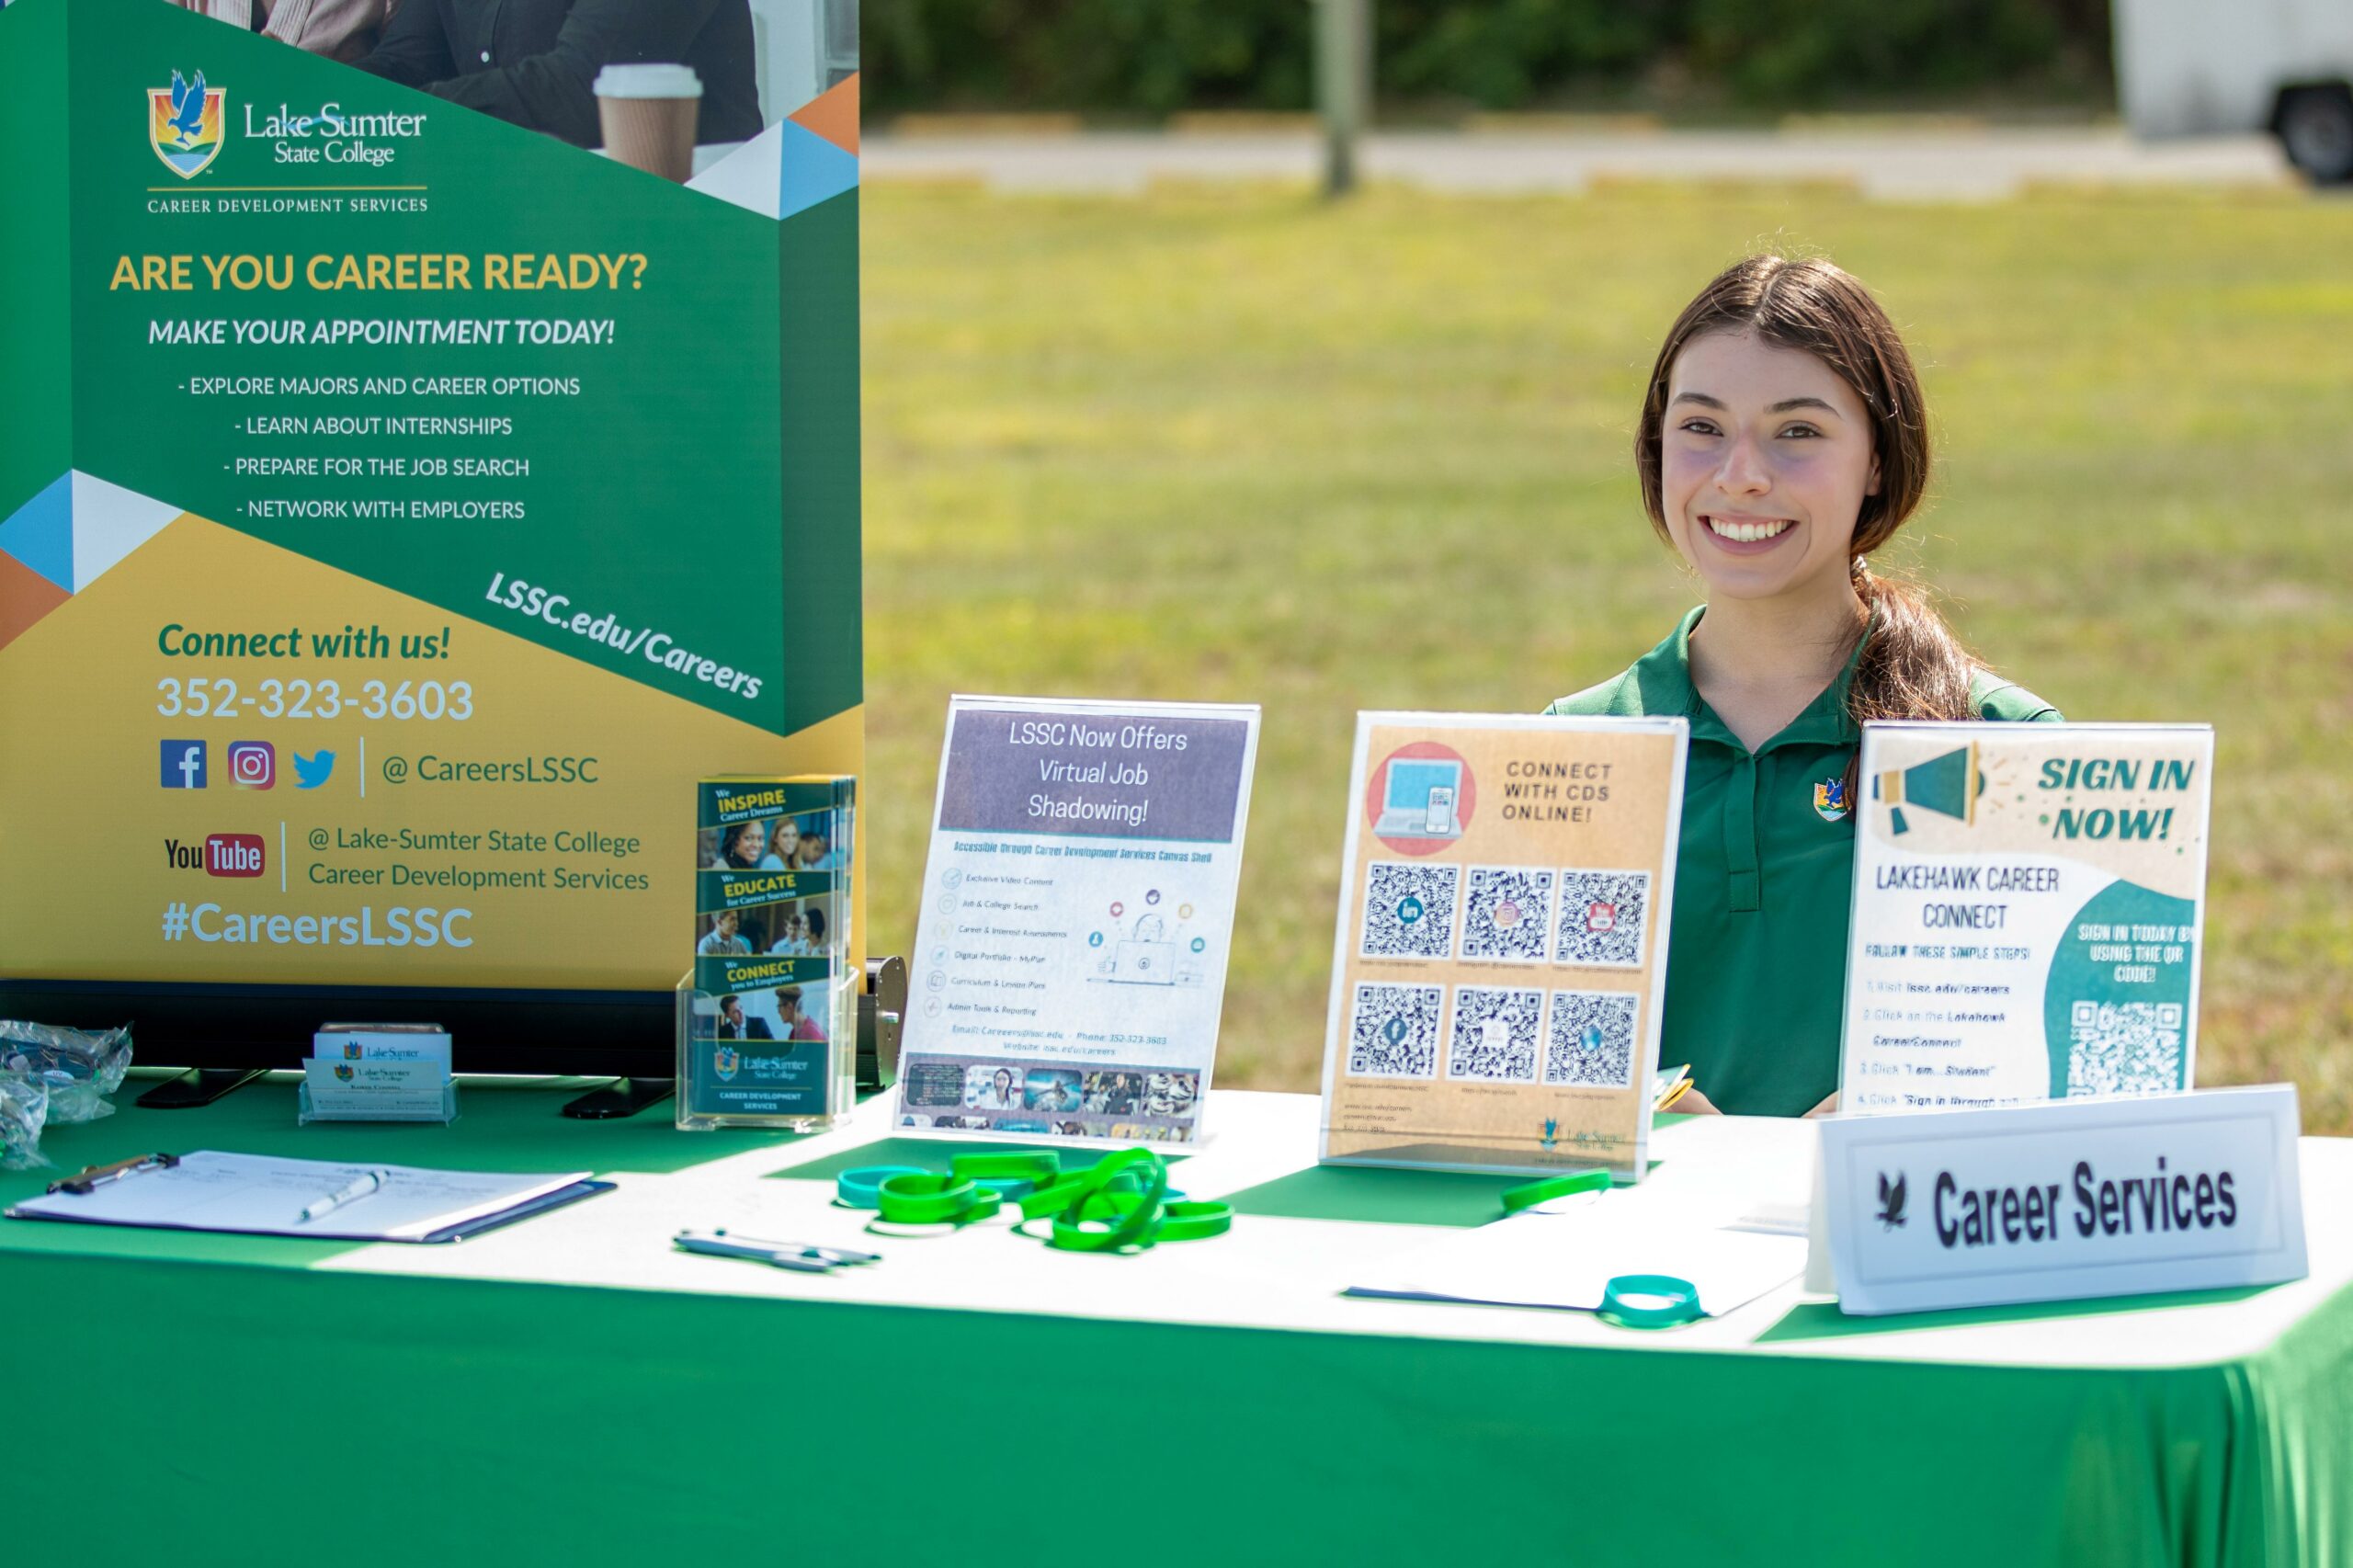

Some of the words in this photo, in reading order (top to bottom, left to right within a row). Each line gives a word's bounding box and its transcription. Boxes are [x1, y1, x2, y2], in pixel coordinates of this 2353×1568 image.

[244, 103, 313, 138] Lake
[320, 103, 426, 137] Sumter
[275, 142, 320, 163] State
[324, 141, 395, 167] College
[147, 199, 211, 213] CAREER
[219, 199, 344, 213] DEVELOPMENT
[350, 199, 428, 213] SERVICES
[109, 256, 194, 291] ARE
[202, 256, 294, 290] YOU
[306, 254, 471, 291] CAREER
[484, 255, 647, 290] READY?
[148, 320, 228, 345] MAKE
[233, 320, 307, 345] YOUR
[312, 320, 509, 345] APPOINTMENT
[516, 320, 615, 345] TODAY!
[190, 378, 275, 395] EXPLORE
[280, 378, 359, 395] MAJORS
[363, 378, 406, 395] AND
[412, 378, 488, 395] CAREER
[492, 378, 581, 396] OPTIONS
[247, 417, 309, 436] LEARN
[313, 417, 381, 436] ABOUT
[387, 417, 513, 437] INTERNSHIPS
[235, 459, 319, 476] PREPARE
[324, 459, 363, 476] FOR
[368, 459, 406, 476] THE
[411, 460, 449, 477] JOB
[453, 459, 529, 477] SEARCH
[248, 501, 348, 518] NETWORK
[353, 501, 405, 518] WITH
[411, 501, 525, 519] EMPLOYERS
[158, 624, 303, 658] Connect
[313, 626, 390, 659] with
[400, 627, 450, 660] us!
[485, 572, 764, 700] LSSC.edu/Careers
[156, 678, 474, 721] 352-323-3603
[1010, 722, 1064, 745] LSSC
[1070, 724, 1116, 747] Now
[1120, 726, 1188, 750] Offers
[382, 756, 408, 784] @
[418, 755, 599, 783] CareersLSSC
[1040, 758, 1107, 784] Virtual
[1109, 764, 1148, 786] Job
[1506, 761, 1613, 780] CONNECT
[2038, 758, 2140, 790] SIGN
[2146, 759, 2196, 790] IN
[718, 789, 786, 813] INSPIRE
[1505, 783, 1558, 801] WITH
[1566, 785, 1611, 801] CDS
[720, 811, 749, 823] Career
[1028, 794, 1149, 826] Shadowing!
[1502, 804, 1592, 824] ONLINE!
[2052, 807, 2175, 841] NOW!
[309, 828, 330, 851] @
[337, 828, 482, 850] Lake-Sumter
[488, 829, 547, 852] State
[554, 830, 641, 858] College
[309, 864, 385, 886] Career
[392, 864, 547, 892] Development
[553, 868, 650, 891] Services
[723, 874, 797, 898] EDUCATE
[1876, 865, 1982, 892] LAKEHAWK
[1986, 866, 2060, 892] CAREER
[726, 897, 739, 907] for
[739, 892, 767, 905] Career
[161, 902, 474, 948] #CareersLSSC
[1923, 903, 2007, 930] CONNECT
[2077, 923, 2110, 941] SIGN
[2112, 925, 2129, 942] IN
[2131, 925, 2177, 942] TODAY
[1865, 944, 1907, 959] FOLLOW
[1913, 945, 1946, 960] THESE
[1950, 946, 1989, 960] SIMPLE
[2090, 944, 2132, 962] USING
[2135, 945, 2162, 963] THE
[2164, 946, 2184, 964] QR
[726, 960, 796, 983] CONNECT
[1932, 1170, 2059, 1249] Career
[2072, 1154, 2239, 1239] Services
